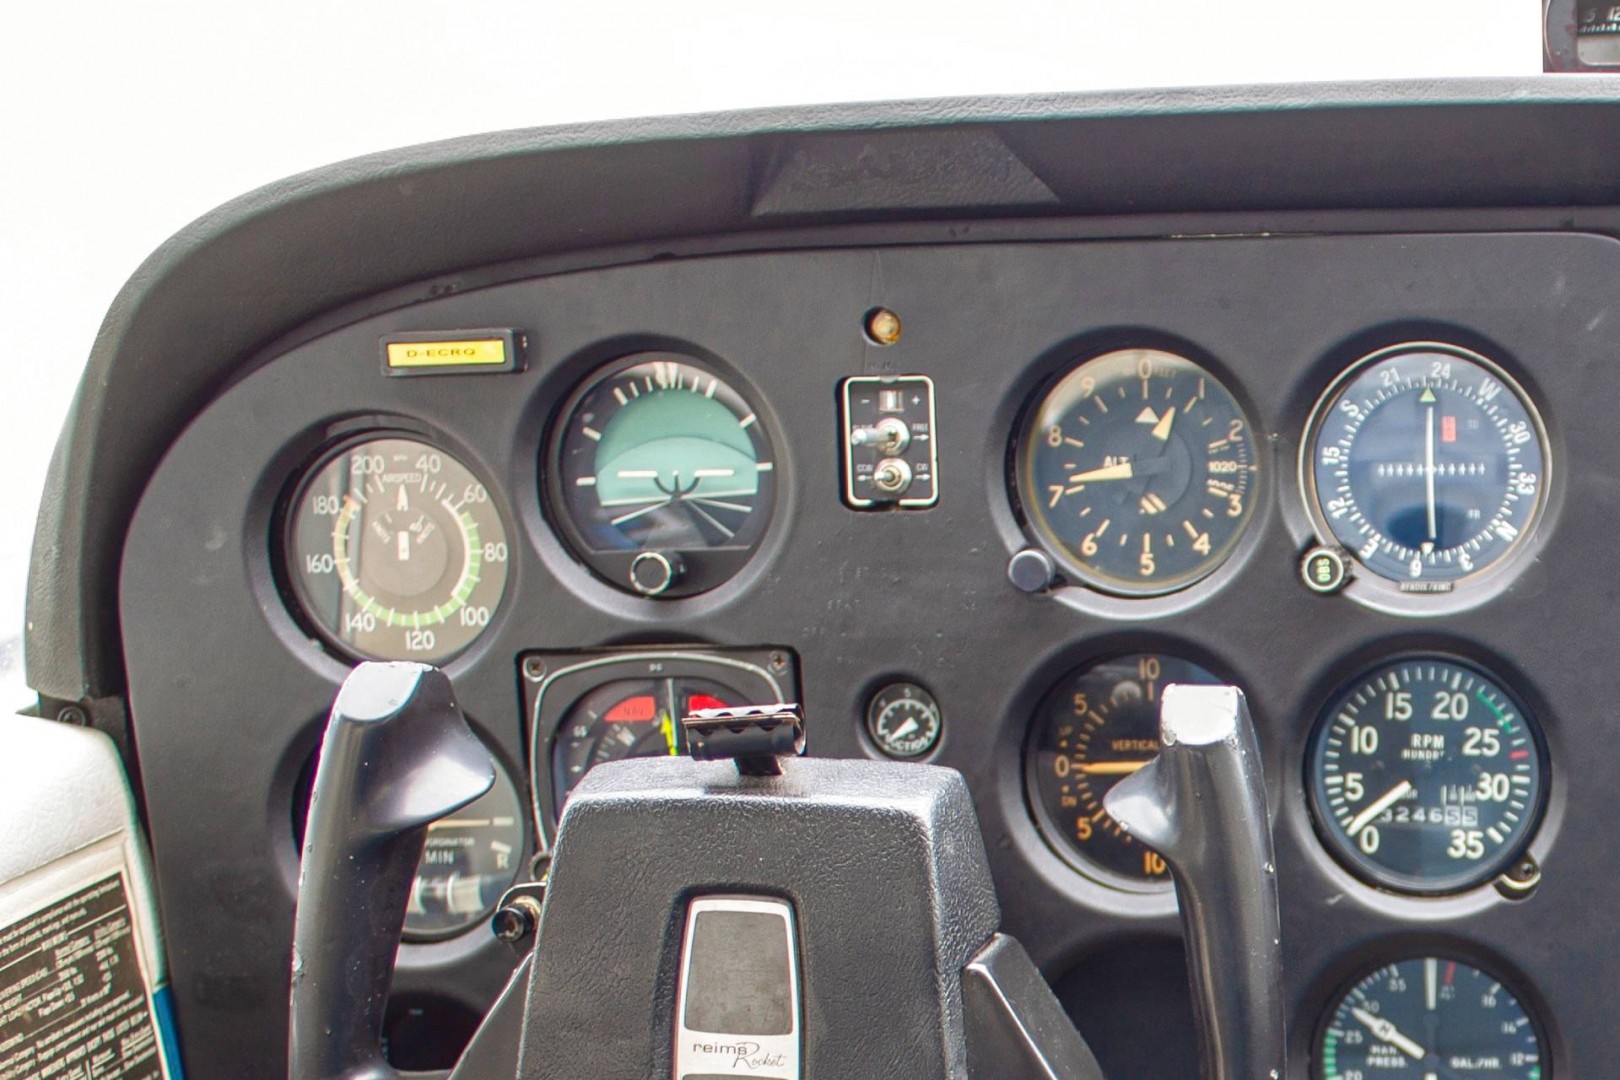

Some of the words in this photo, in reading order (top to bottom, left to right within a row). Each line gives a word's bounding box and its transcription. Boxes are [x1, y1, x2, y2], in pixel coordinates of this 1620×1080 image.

[1138, 357, 1152, 379] 0
[1380, 366, 1401, 386] 21
[1431, 361, 1452, 379] 24
[1081, 377, 1096, 398] 9
[1478, 377, 1501, 400] W
[1339, 398, 1360, 417] S
[1048, 426, 1062, 446] 8
[1227, 419, 1244, 441] 2
[1509, 420, 1532, 443] 30
[351, 455, 384, 474] 200
[415, 454, 441, 473] 40
[1103, 455, 1129, 467] ALT
[1208, 460, 1238, 473] 1020
[1321, 446, 1340, 466] 15
[382, 473, 421, 482] AIRSPEED
[1517, 472, 1537, 495] 33
[464, 483, 486, 503] 60
[1049, 486, 1065, 507] 7
[312, 495, 338, 514] 180
[1227, 494, 1243, 516] 3
[1327, 497, 1349, 518] 12
[1467, 509, 1480, 520] FR
[1496, 520, 1518, 542] N
[484, 542, 507, 562] 80
[1081, 535, 1098, 556] 6
[1192, 533, 1211, 555] 4
[1359, 538, 1379, 559] E
[306, 554, 332, 574] 160
[1140, 554, 1156, 576] 5
[1317, 557, 1331, 582] OBS
[1458, 554, 1475, 571] 3
[345, 613, 375, 632] 140
[460, 607, 489, 627] 100
[405, 631, 435, 651] 120
[1139, 658, 1160, 680] 10
[1073, 693, 1088, 716] 5
[1385, 691, 1413, 720] 15
[1431, 691, 1469, 721] 20
[1112, 739, 1160, 750] VERTICAL
[1350, 726, 1378, 755] 10
[1411, 733, 1445, 749] RPM
[1462, 727, 1500, 757] 25
[1054, 756, 1070, 778] 0
[1344, 773, 1364, 800] 5
[1475, 773, 1510, 801] 30
[1077, 817, 1092, 840] 5
[1358, 825, 1380, 854] 0
[1447, 829, 1485, 859] 35
[426, 850, 454, 864] MIN
[496, 853, 509, 869] R
[1143, 852, 1166, 874] 10
[1389, 977, 1407, 992] 35
[1344, 1030, 1363, 1044] 25
[693, 1042, 748, 1056] reims
[732, 1041, 787, 1070] Rocket
[1510, 1052, 1524, 1065] 12
[1367, 1057, 1408, 1068] PRESS.
